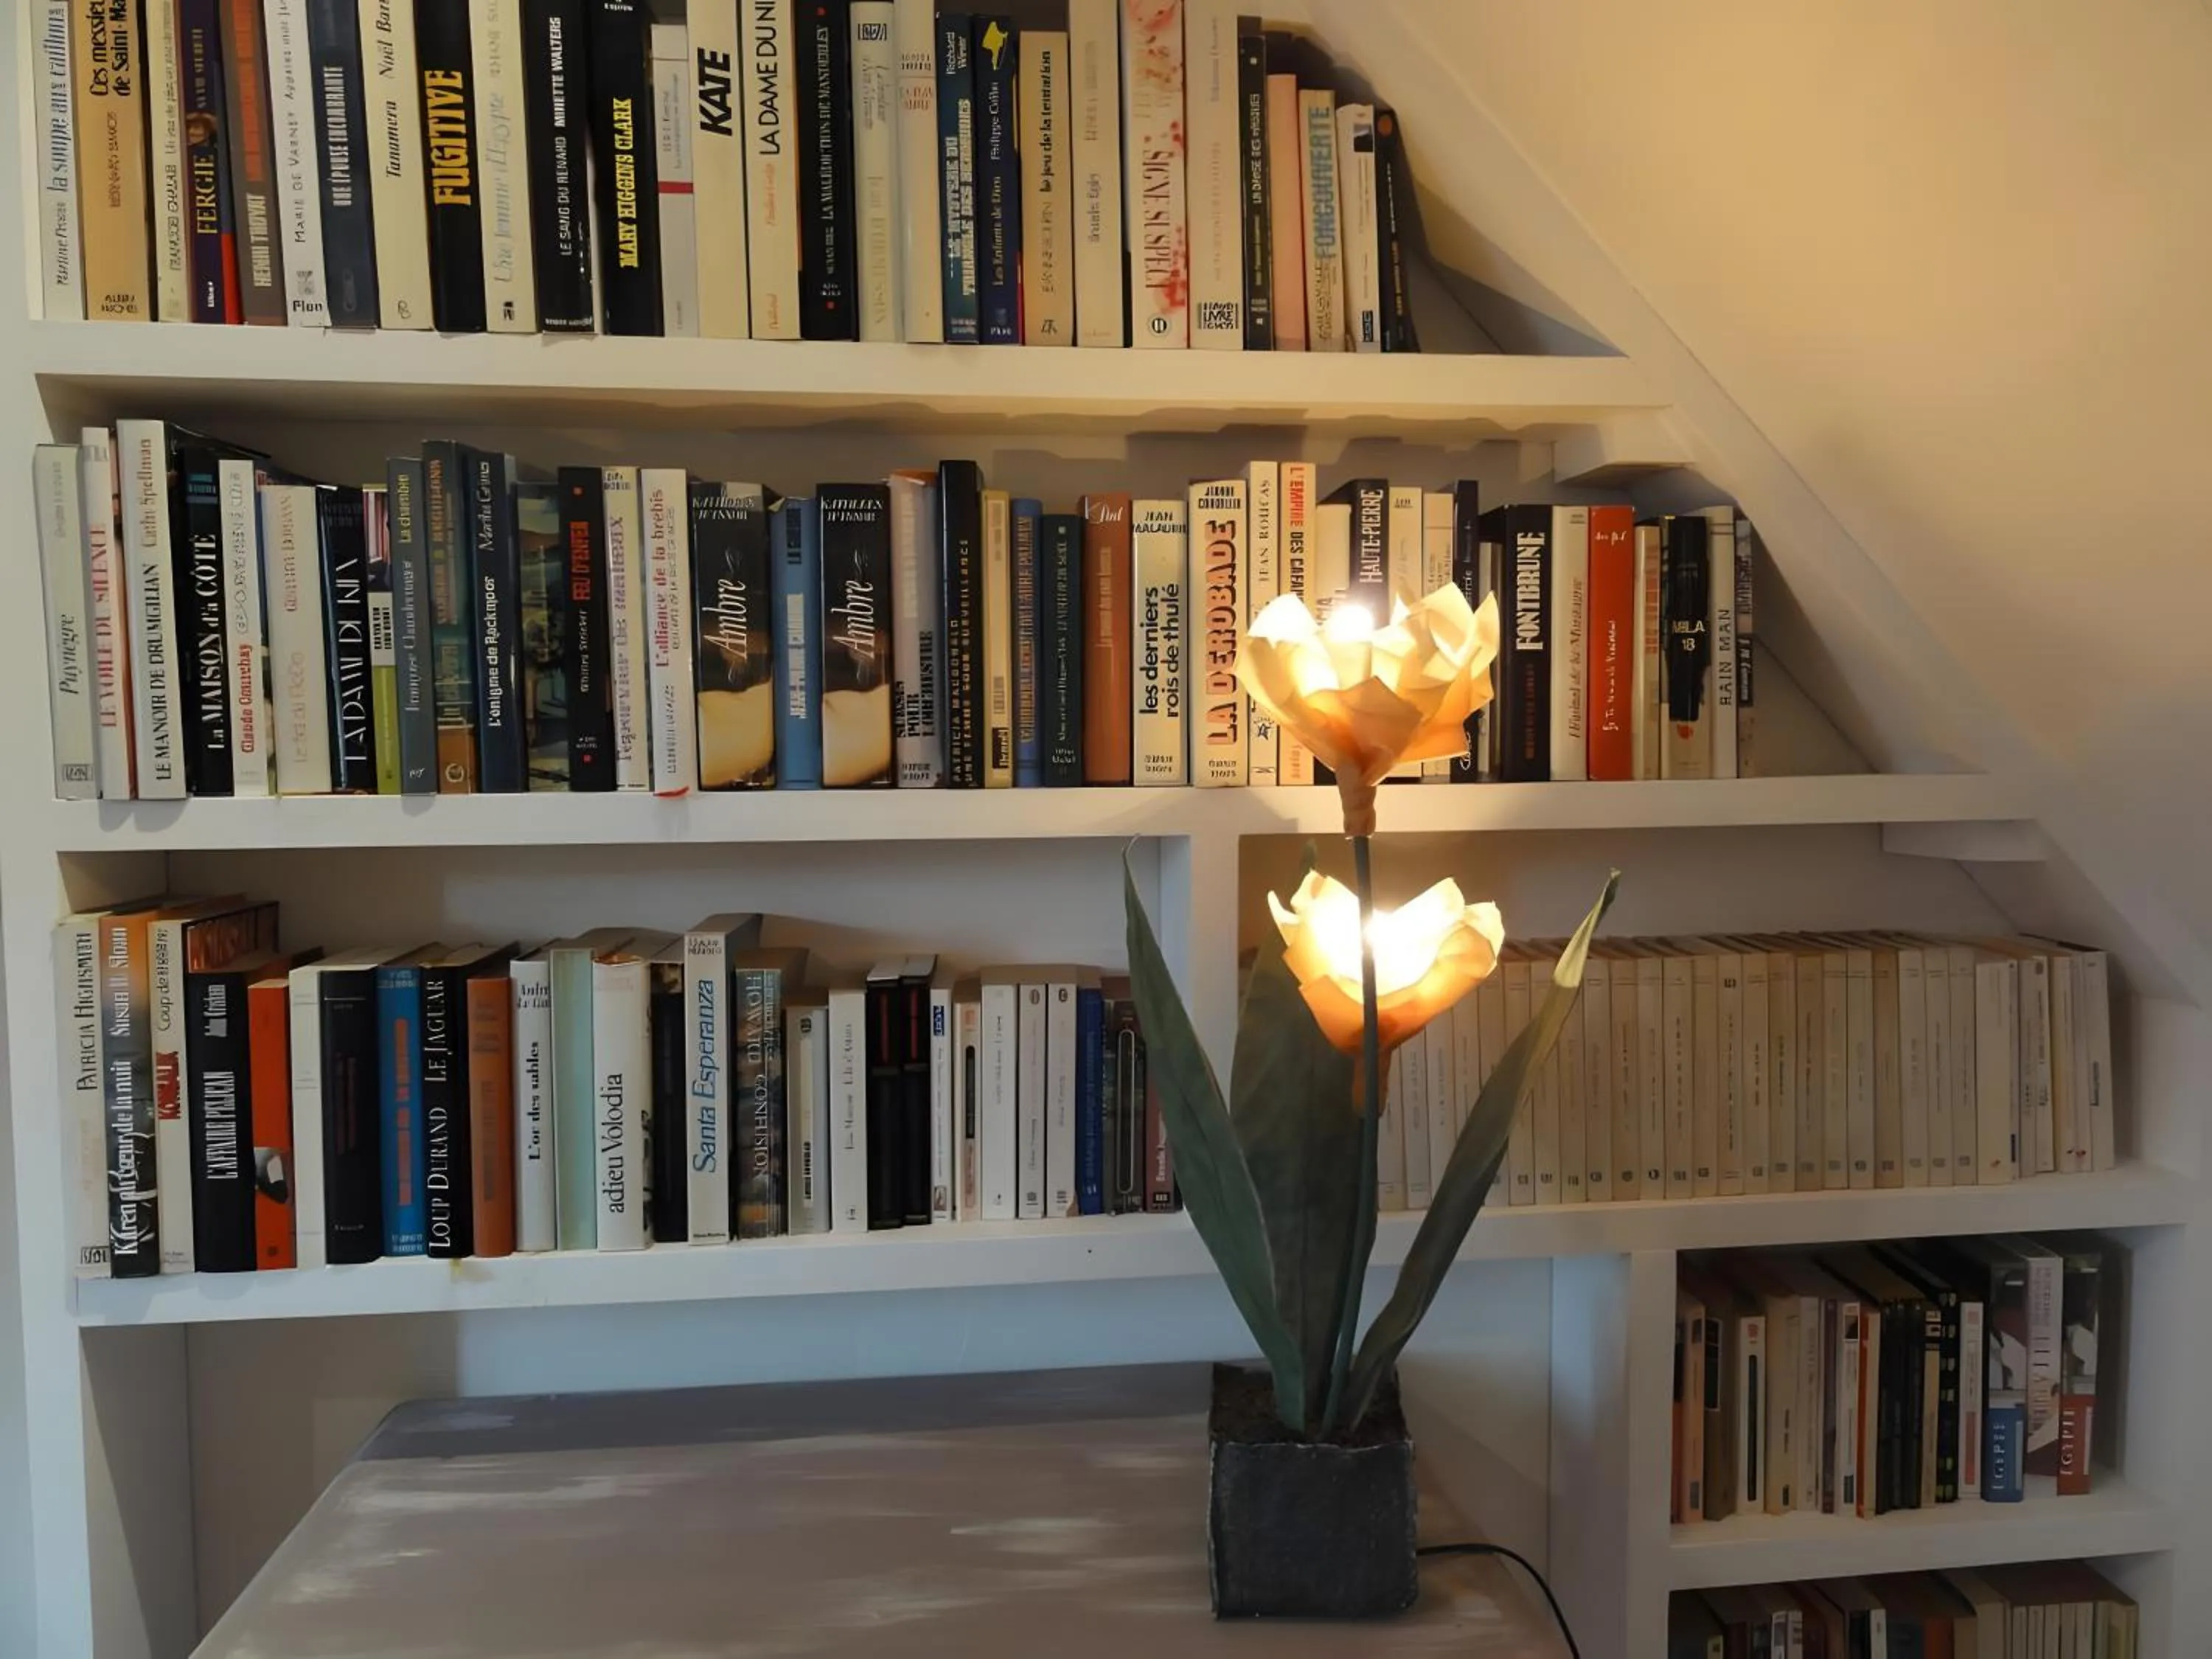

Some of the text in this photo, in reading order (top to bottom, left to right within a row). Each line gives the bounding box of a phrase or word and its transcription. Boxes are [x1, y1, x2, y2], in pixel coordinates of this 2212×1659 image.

[549, 16, 563, 71] WALTERS
[755, 26, 777, 57] DU
[88, 67, 108, 97] Ces
[111, 76, 131, 97] de
[698, 47, 733, 136] KATE
[756, 63, 779, 125] DAME
[424, 70, 471, 206] FUGITIVE
[758, 129, 781, 156] LA
[192, 154, 218, 234] FERGIE
[557, 187, 568, 204] DU
[613, 97, 639, 268] MARY HIGGINS CLARK
[1308, 106, 1337, 260] FONCOUVERTE
[557, 207, 571, 240] SANG
[560, 243, 571, 255] LE
[649, 488, 665, 540] brebis
[1289, 531, 1304, 554] DES
[1360, 489, 1384, 583] HAUTE-PIERRE
[650, 546, 666, 561] la
[653, 565, 667, 587] de
[1261, 546, 1271, 582] JEAN
[703, 577, 748, 660] Ambre
[830, 579, 875, 658] Ambre
[1204, 520, 1237, 694] DEROBADE
[1516, 531, 1545, 650] FONTBRUNE
[148, 669, 165, 689] DE
[198, 633, 223, 723] MAISON
[1139, 587, 1159, 714] les derniers
[1159, 583, 1179, 717] rois de thulé
[1717, 608, 1733, 706] RAIN MAN
[150, 695, 170, 759] MANOIR
[1205, 702, 1238, 745] LA
[74, 1024, 99, 1091] PATRICIA
[691, 979, 720, 1098] Esperanza
[110, 1060, 133, 1091] nuit
[423, 980, 453, 1248] LOUP DURAND LE JAGUAR
[599, 1073, 625, 1214] adieu Volodia
[692, 1106, 717, 1173] Santa
